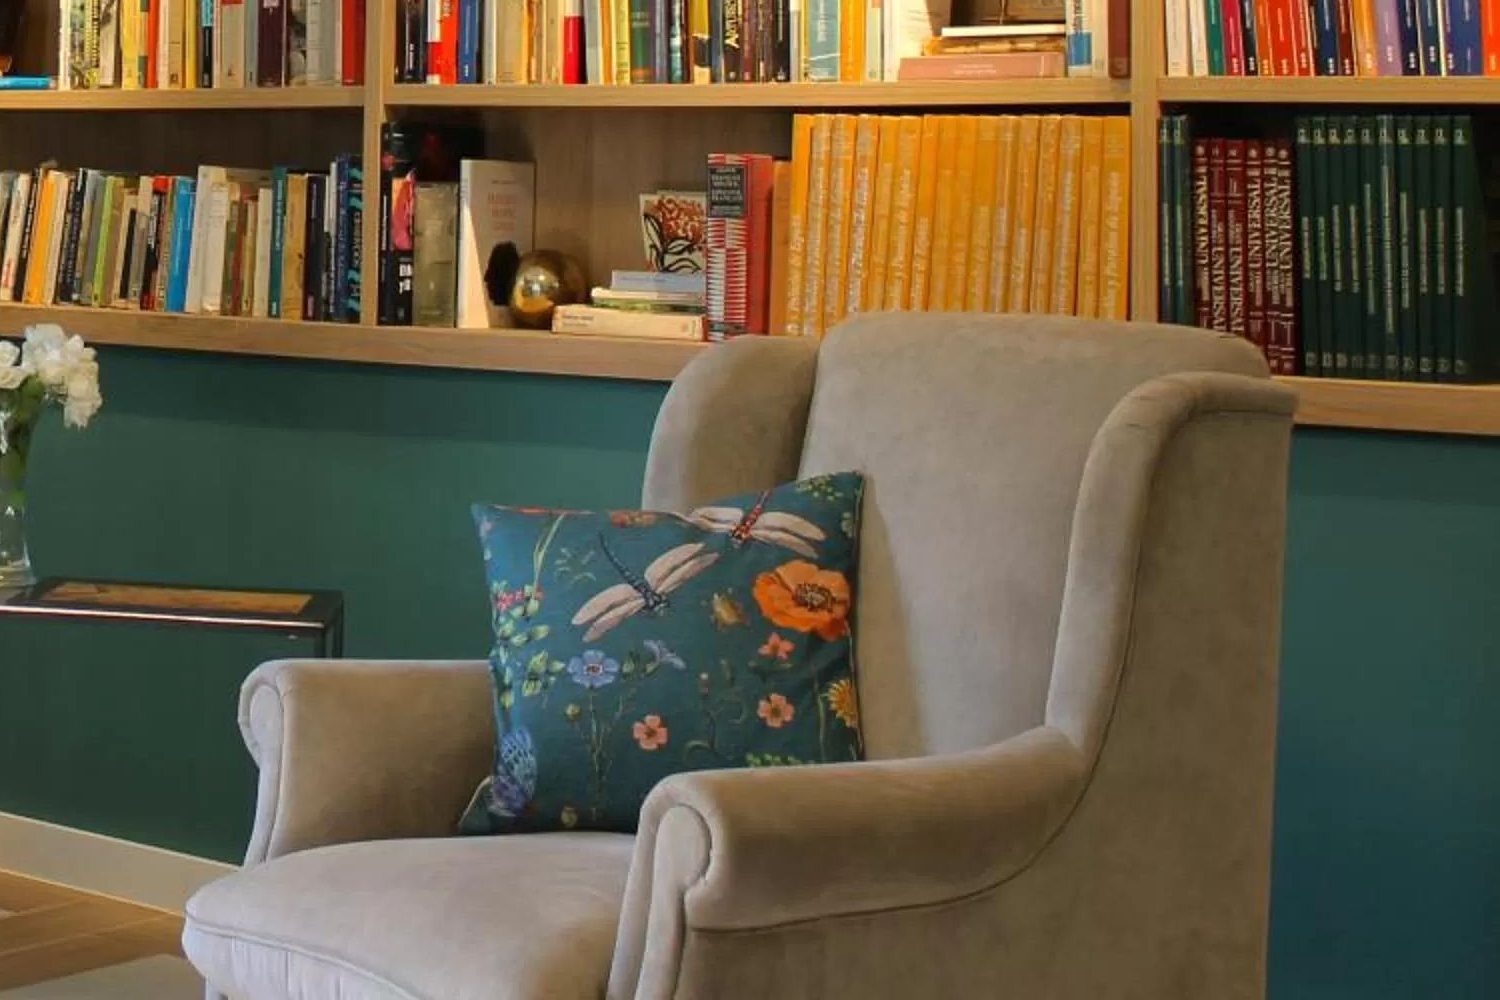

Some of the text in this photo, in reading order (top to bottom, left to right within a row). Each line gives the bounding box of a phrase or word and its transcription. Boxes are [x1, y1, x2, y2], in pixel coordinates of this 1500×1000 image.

[1196, 176, 1209, 265] UNIVERSAL
[1247, 178, 1262, 268] UNIVERSAL
[1263, 177, 1279, 267] UNIVERSAL
[1278, 179, 1292, 269] UNIVERSAL
